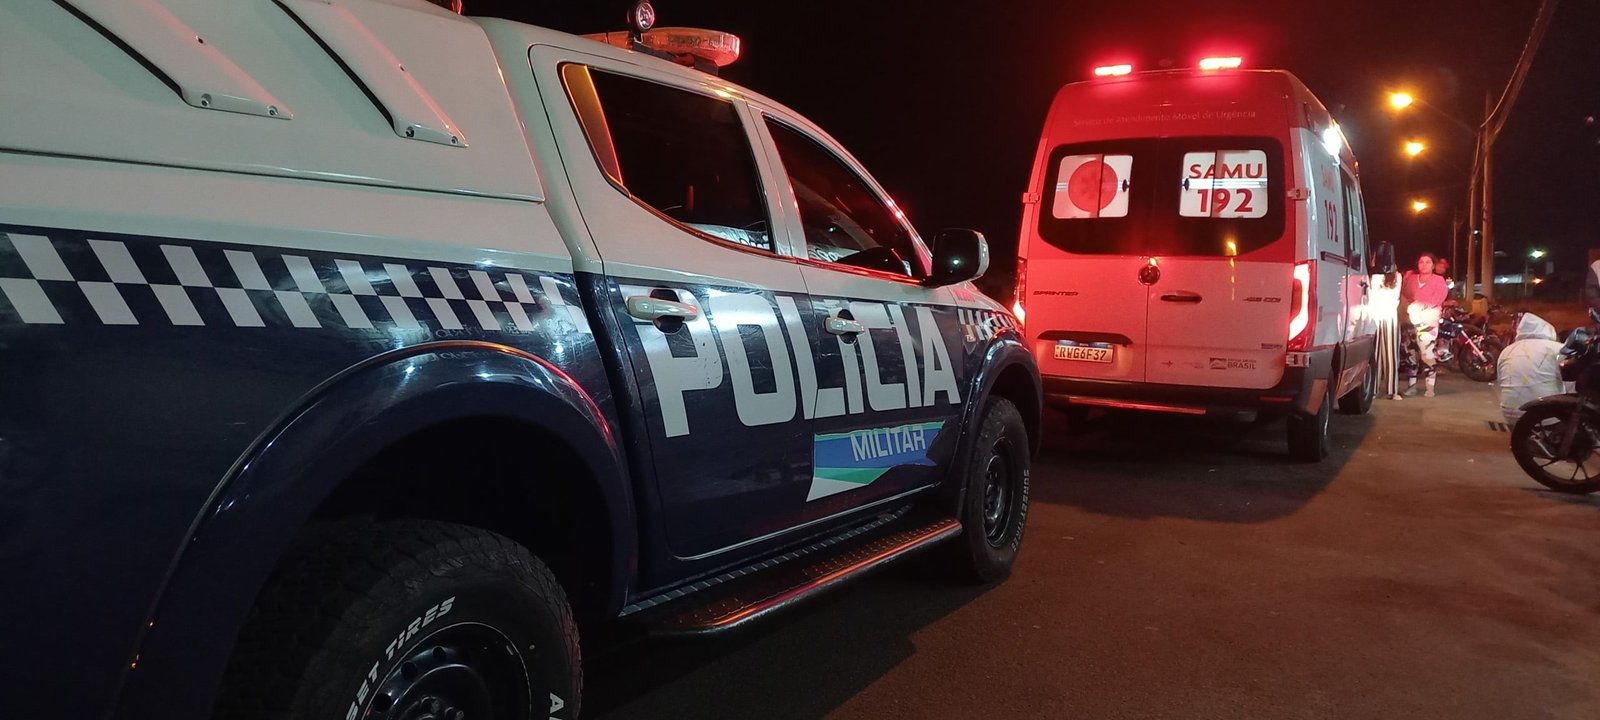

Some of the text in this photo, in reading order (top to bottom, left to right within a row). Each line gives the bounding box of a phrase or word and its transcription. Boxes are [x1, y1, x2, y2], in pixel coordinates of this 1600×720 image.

[1202, 111, 1214, 120] de
[1189, 163, 1263, 179] SAMU
[1198, 188, 1253, 213] 192
[1325, 199, 1338, 243] 192
[1227, 361, 1257, 370] BRASIL
[850, 425, 926, 462] MILITAR
[386, 596, 456, 661] TIRES
